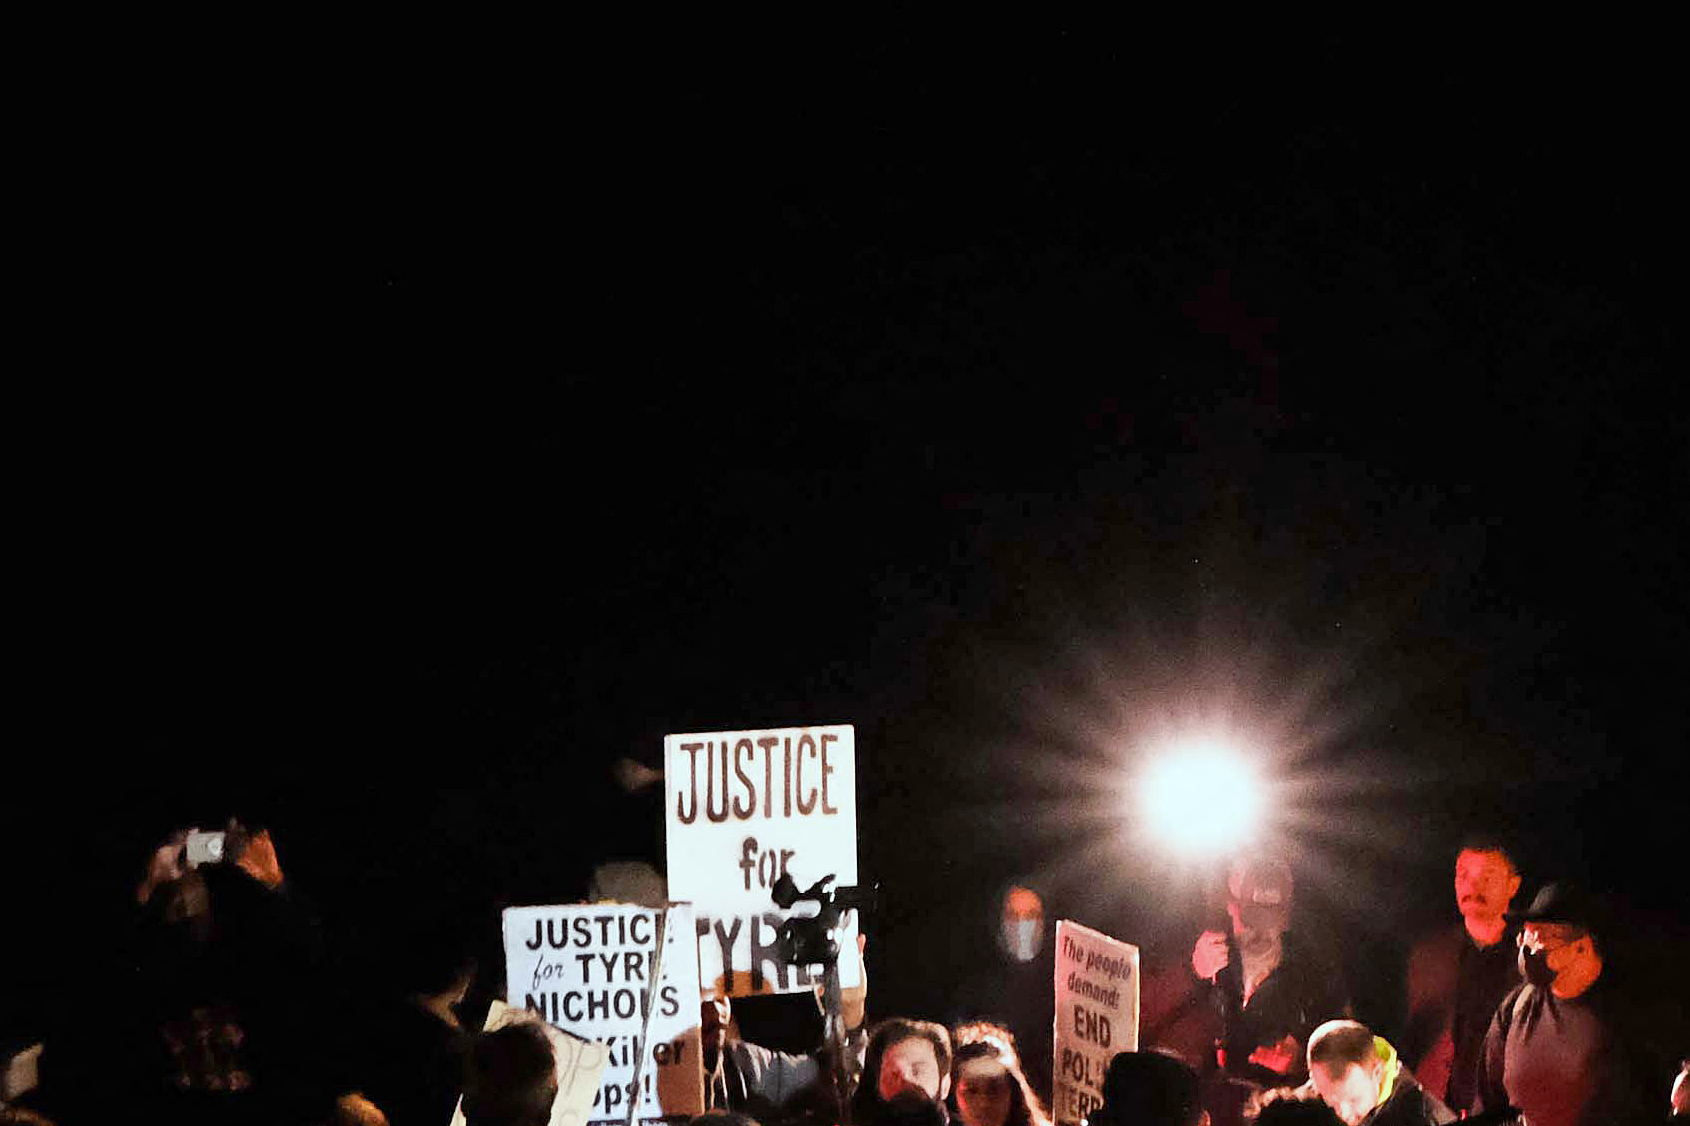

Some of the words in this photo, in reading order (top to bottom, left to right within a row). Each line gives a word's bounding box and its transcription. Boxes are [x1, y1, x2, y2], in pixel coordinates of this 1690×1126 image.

[677, 734, 839, 825] JUSTICE
[739, 836, 795, 890] for
[532, 953, 564, 990] for
[697, 914, 827, 992] YR
[1063, 935, 1083, 963] The
[1086, 951, 1131, 981] people
[1074, 1005, 1111, 1048] END
[597, 1035, 685, 1066] Kiler
